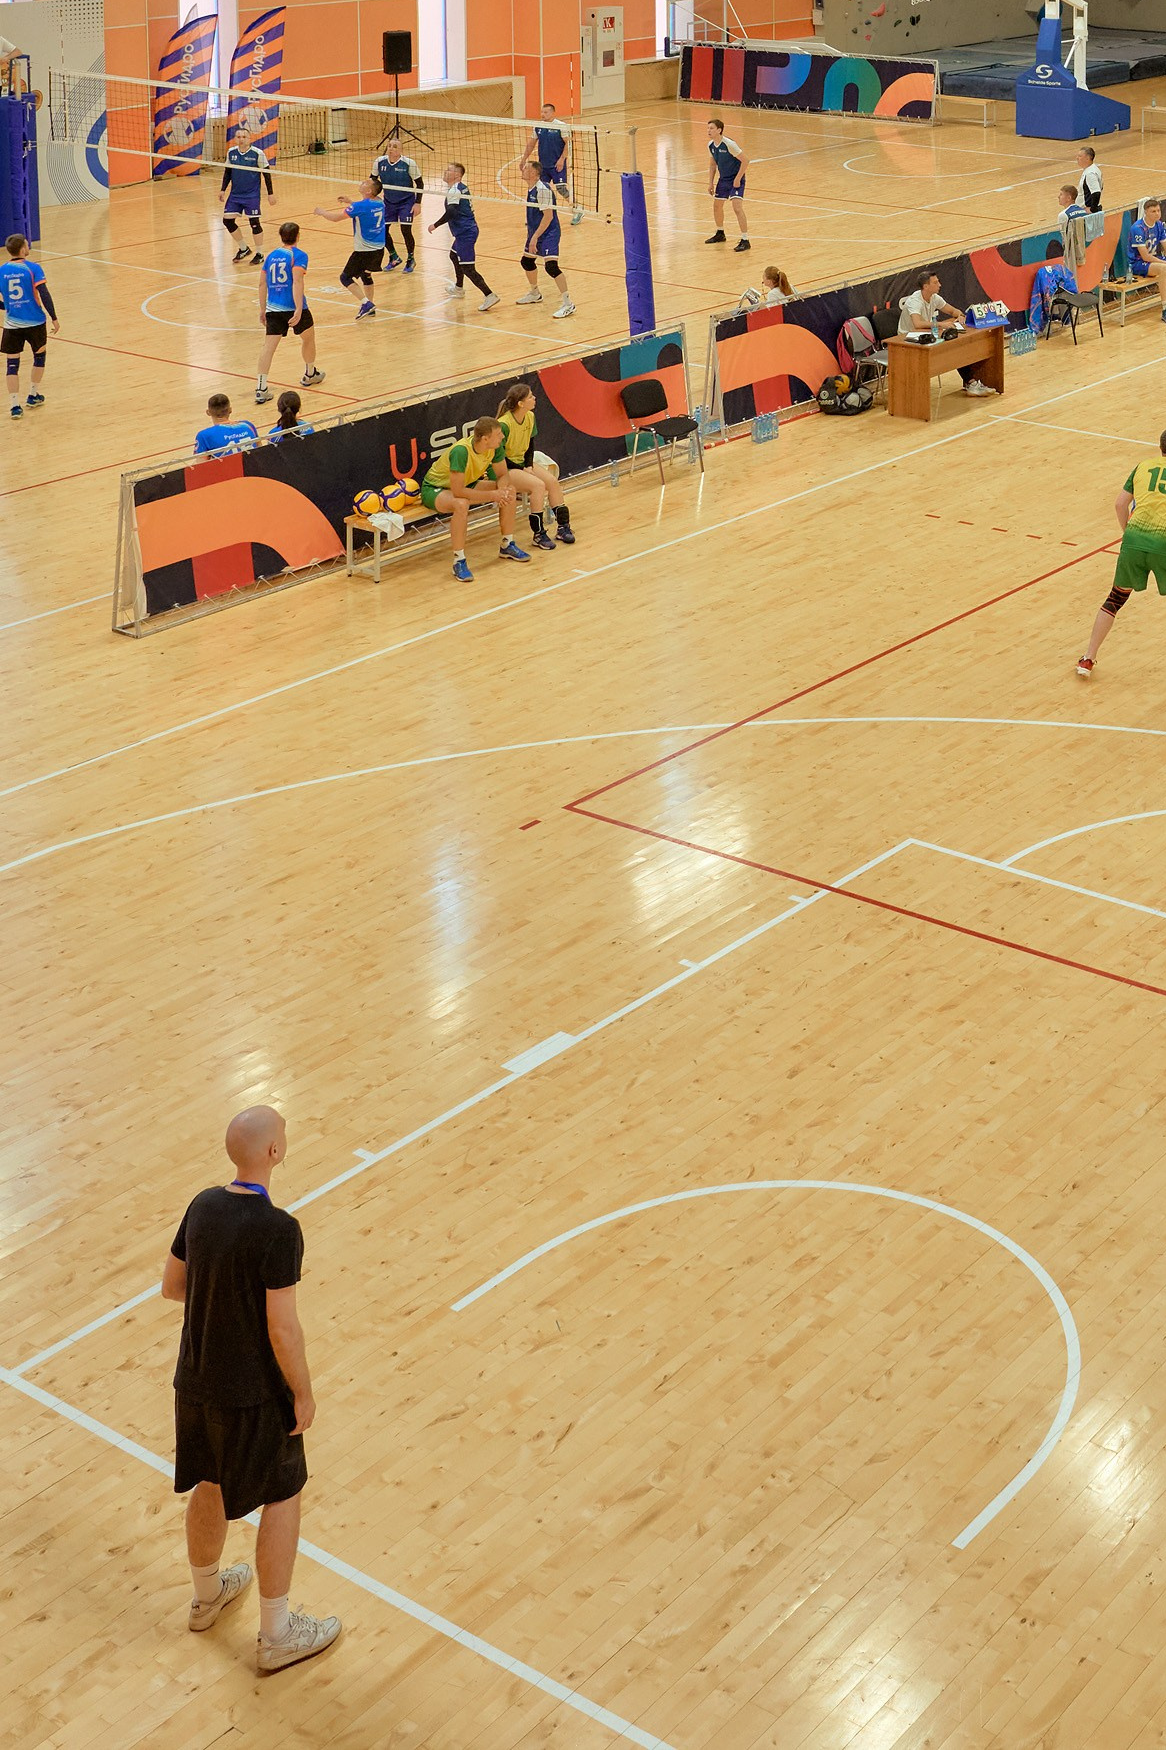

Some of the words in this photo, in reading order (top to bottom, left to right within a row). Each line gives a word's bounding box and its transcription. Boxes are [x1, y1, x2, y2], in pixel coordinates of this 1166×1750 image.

[374, 211, 383, 228] 7
[1135, 234, 1143, 242] 22
[269, 262, 288, 284] 13
[8, 278, 24, 300] 5
[976, 306, 984, 317] 5
